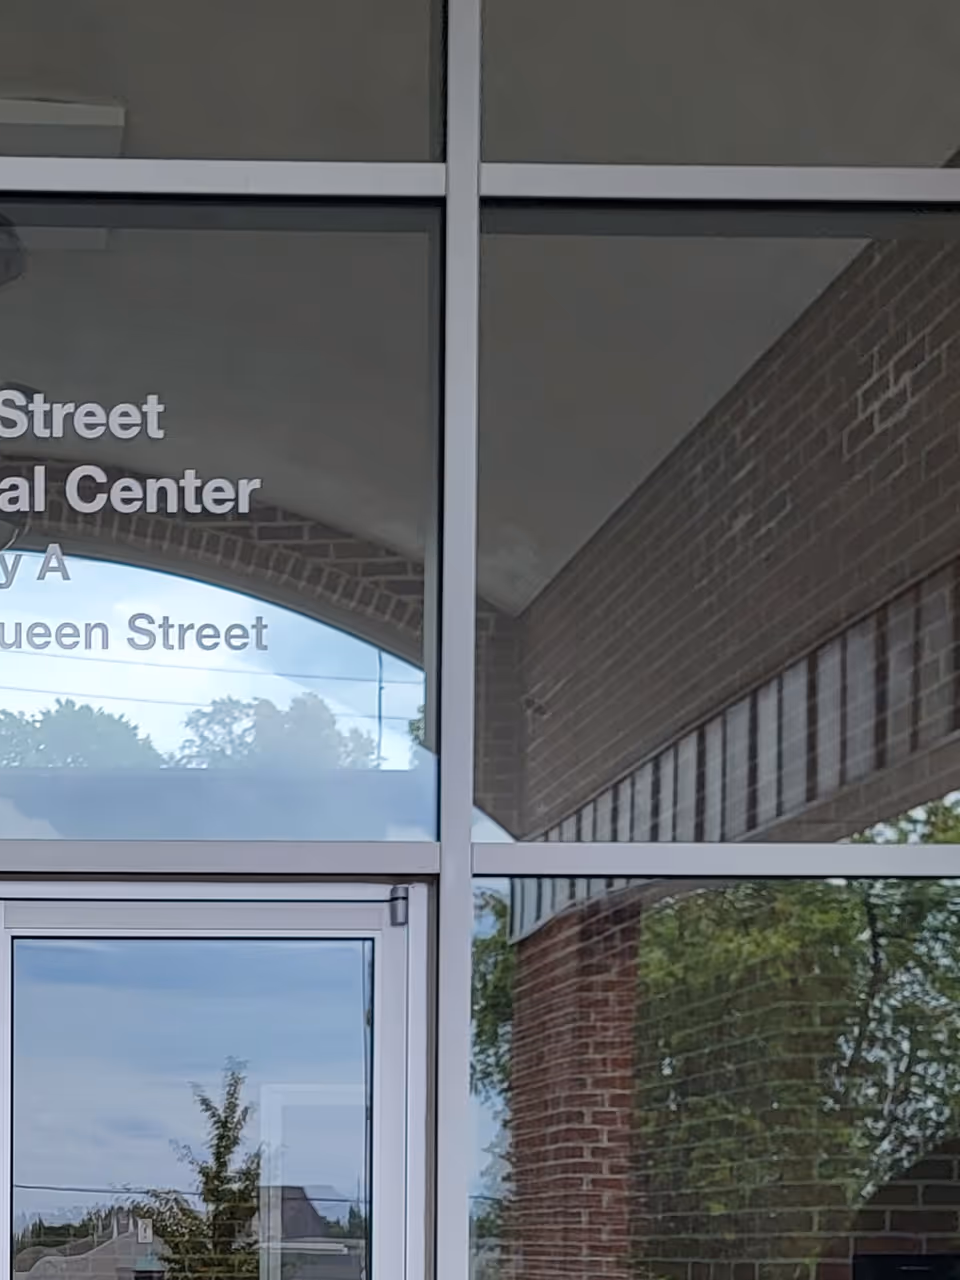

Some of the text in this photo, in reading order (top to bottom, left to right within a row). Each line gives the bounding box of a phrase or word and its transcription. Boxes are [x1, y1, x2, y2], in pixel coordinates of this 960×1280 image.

[65, 465, 261, 515] Center
[36, 543, 71, 581] A
[126, 612, 269, 652] Street
